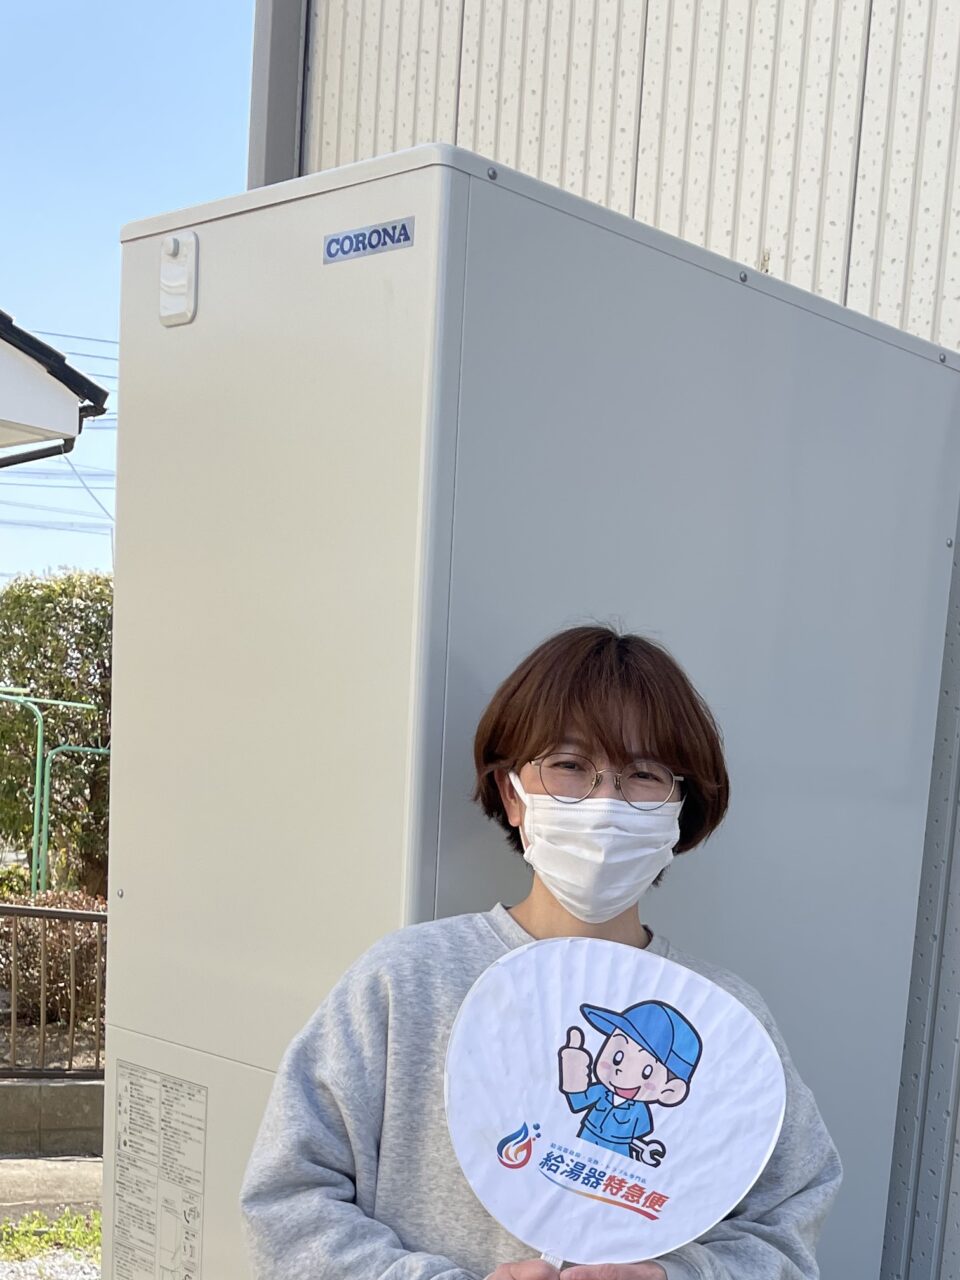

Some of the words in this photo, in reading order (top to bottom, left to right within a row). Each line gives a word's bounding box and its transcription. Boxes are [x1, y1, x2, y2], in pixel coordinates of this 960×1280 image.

[326, 223, 410, 258] CORONA
[539, 1151, 669, 1212] 給湯器特急便
